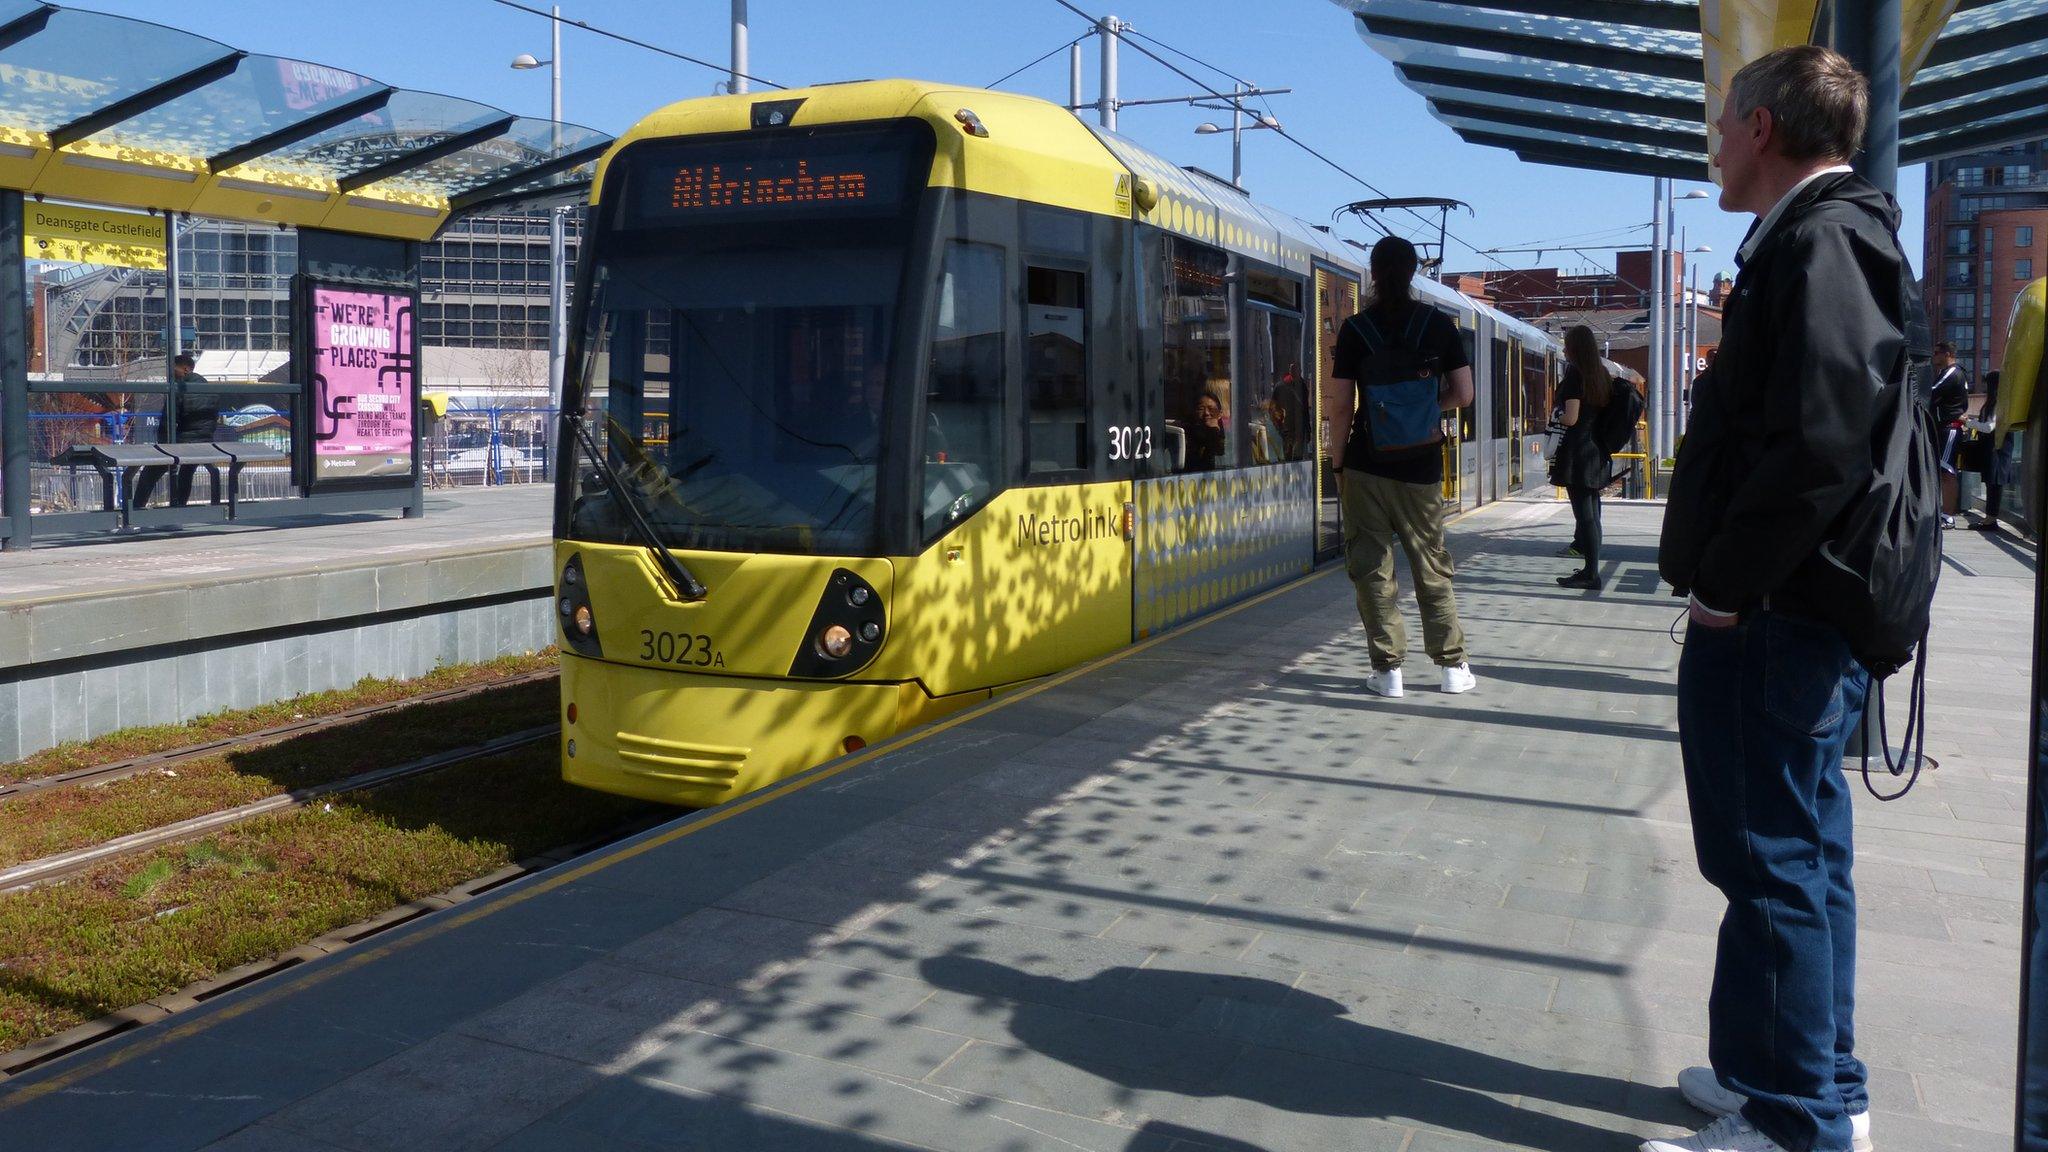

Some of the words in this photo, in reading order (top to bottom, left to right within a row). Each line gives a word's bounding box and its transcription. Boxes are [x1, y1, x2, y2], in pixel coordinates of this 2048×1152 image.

[672, 159, 866, 208] Altrincham
[36, 213, 99, 233] Deansgate
[102, 221, 161, 238] Castlefield
[331, 303, 374, 327] WE'RE
[331, 324, 391, 349] GROWING
[331, 346, 378, 369] PLACES
[383, 403, 396, 412] WILL
[389, 395, 401, 404] CITY
[146, 416, 160, 427] Ma
[357, 410, 373, 420] BRING
[374, 411, 388, 420] MORE
[389, 411, 407, 421] TRAMS
[357, 419, 381, 428] THROUGH
[381, 420, 392, 428] THE
[356, 428, 373, 437] HEART
[374, 428, 381, 437] OF
[381, 428, 391, 437] THE
[392, 428, 404, 437] CITY
[1108, 425, 1152, 461] 3023
[1018, 507, 1118, 547] Metrolink
[640, 629, 725, 668] 3023A
